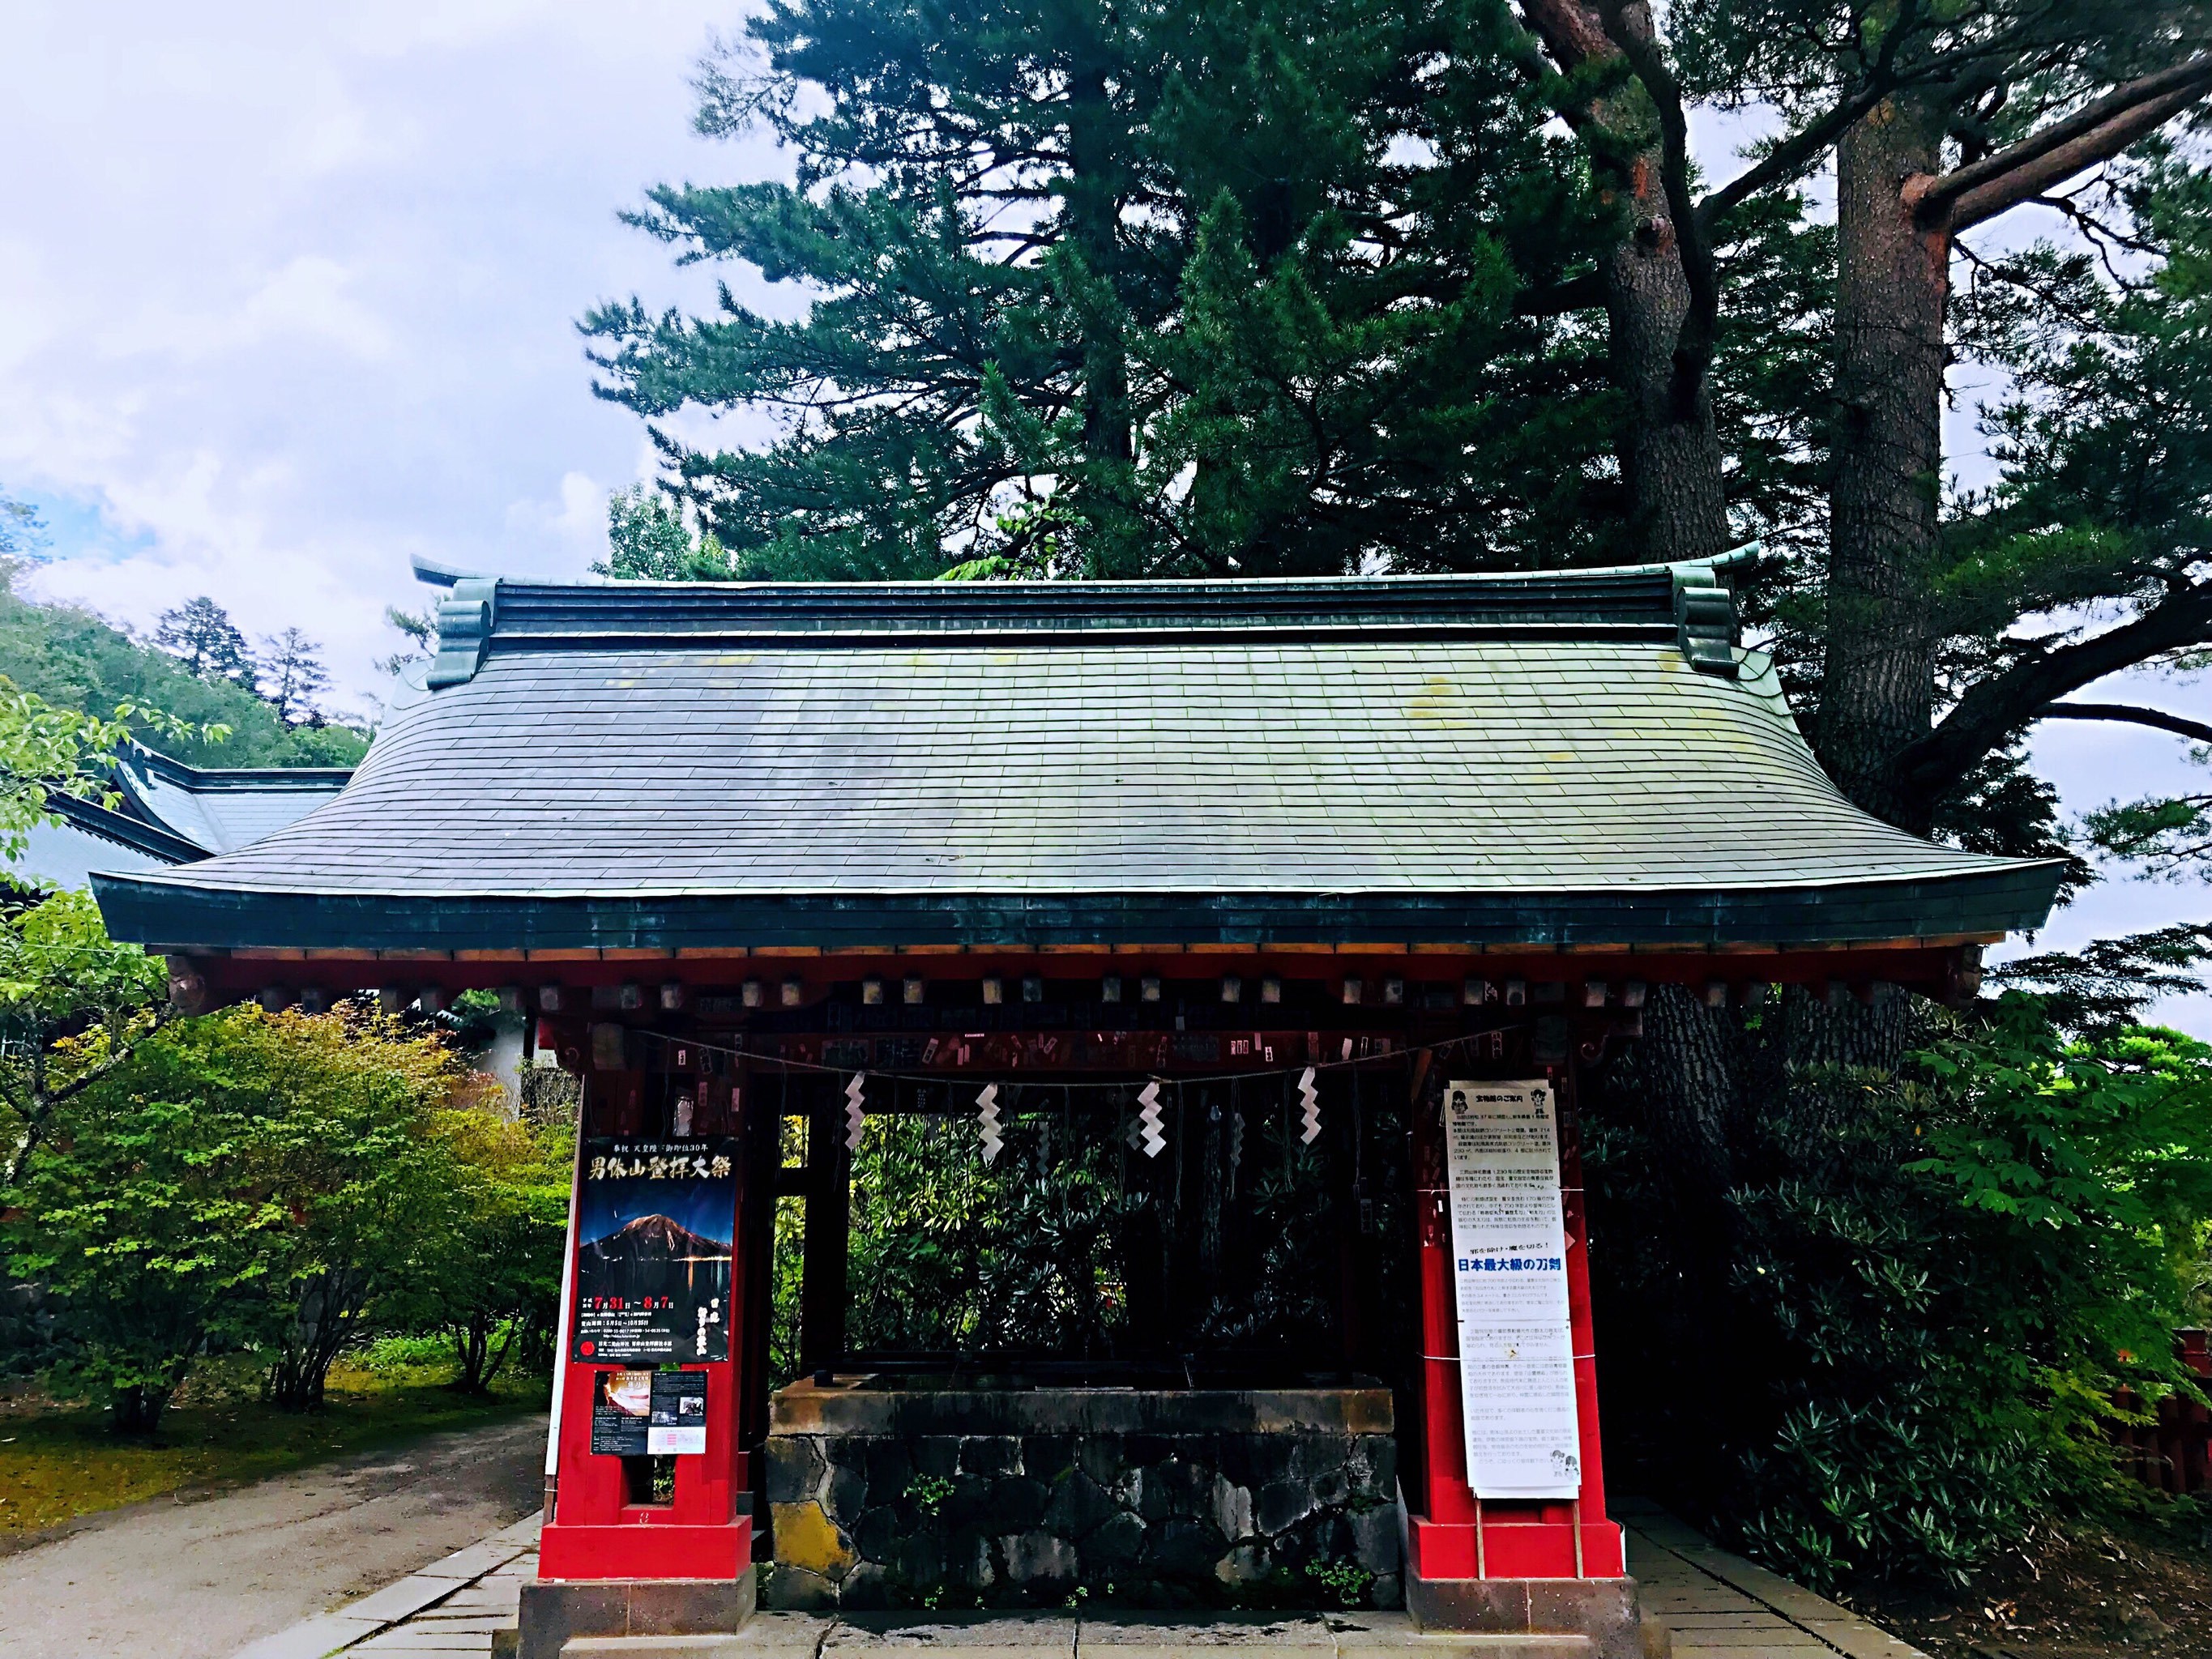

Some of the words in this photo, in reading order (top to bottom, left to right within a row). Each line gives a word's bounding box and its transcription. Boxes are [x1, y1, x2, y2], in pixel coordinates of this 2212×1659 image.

[588, 1155, 732, 1179] 男体山登拝大祭
[1458, 1257, 1561, 1272] 日本最大級の刀剣
